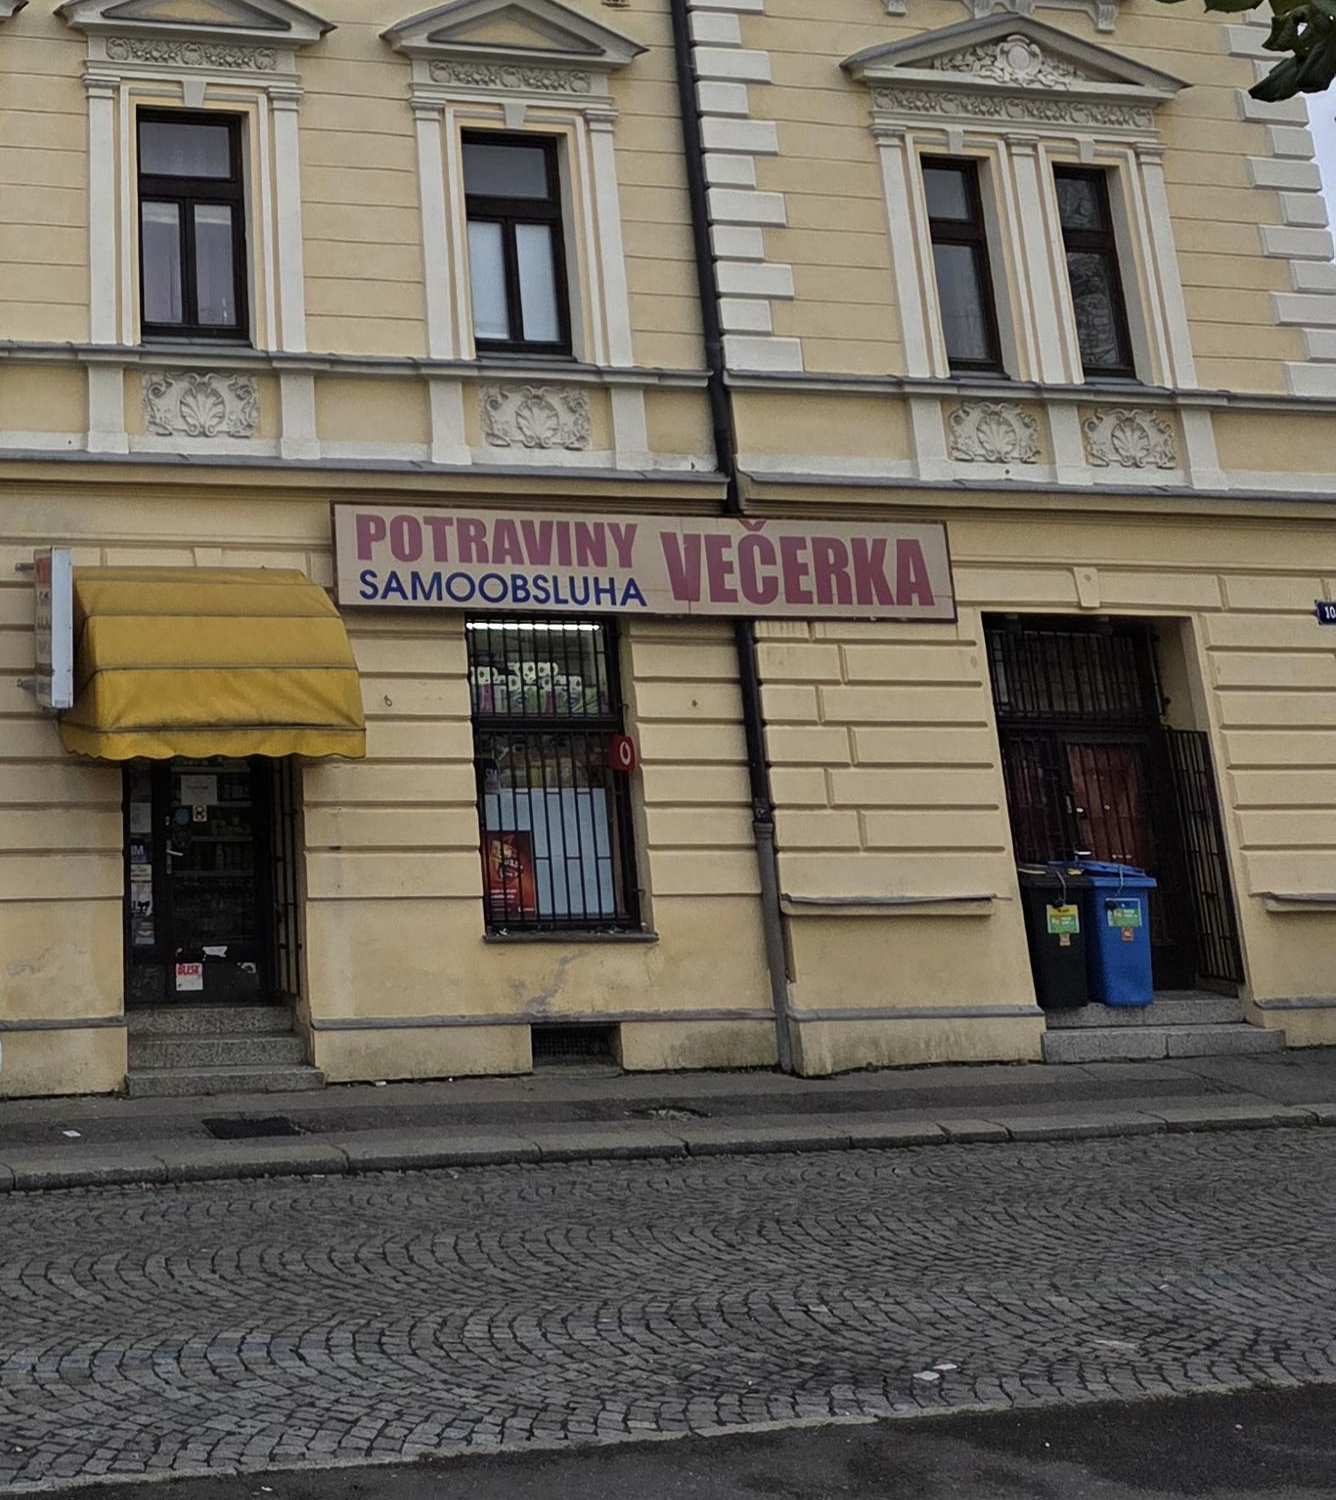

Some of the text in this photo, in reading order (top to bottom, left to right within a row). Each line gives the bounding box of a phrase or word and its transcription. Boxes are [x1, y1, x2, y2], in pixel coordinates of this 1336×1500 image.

[354, 513, 936, 607] POTRAVINY VEČERKA
[359, 568, 648, 607] SAMOOBSLUHA
[1324, 605, 1336, 619] 10
